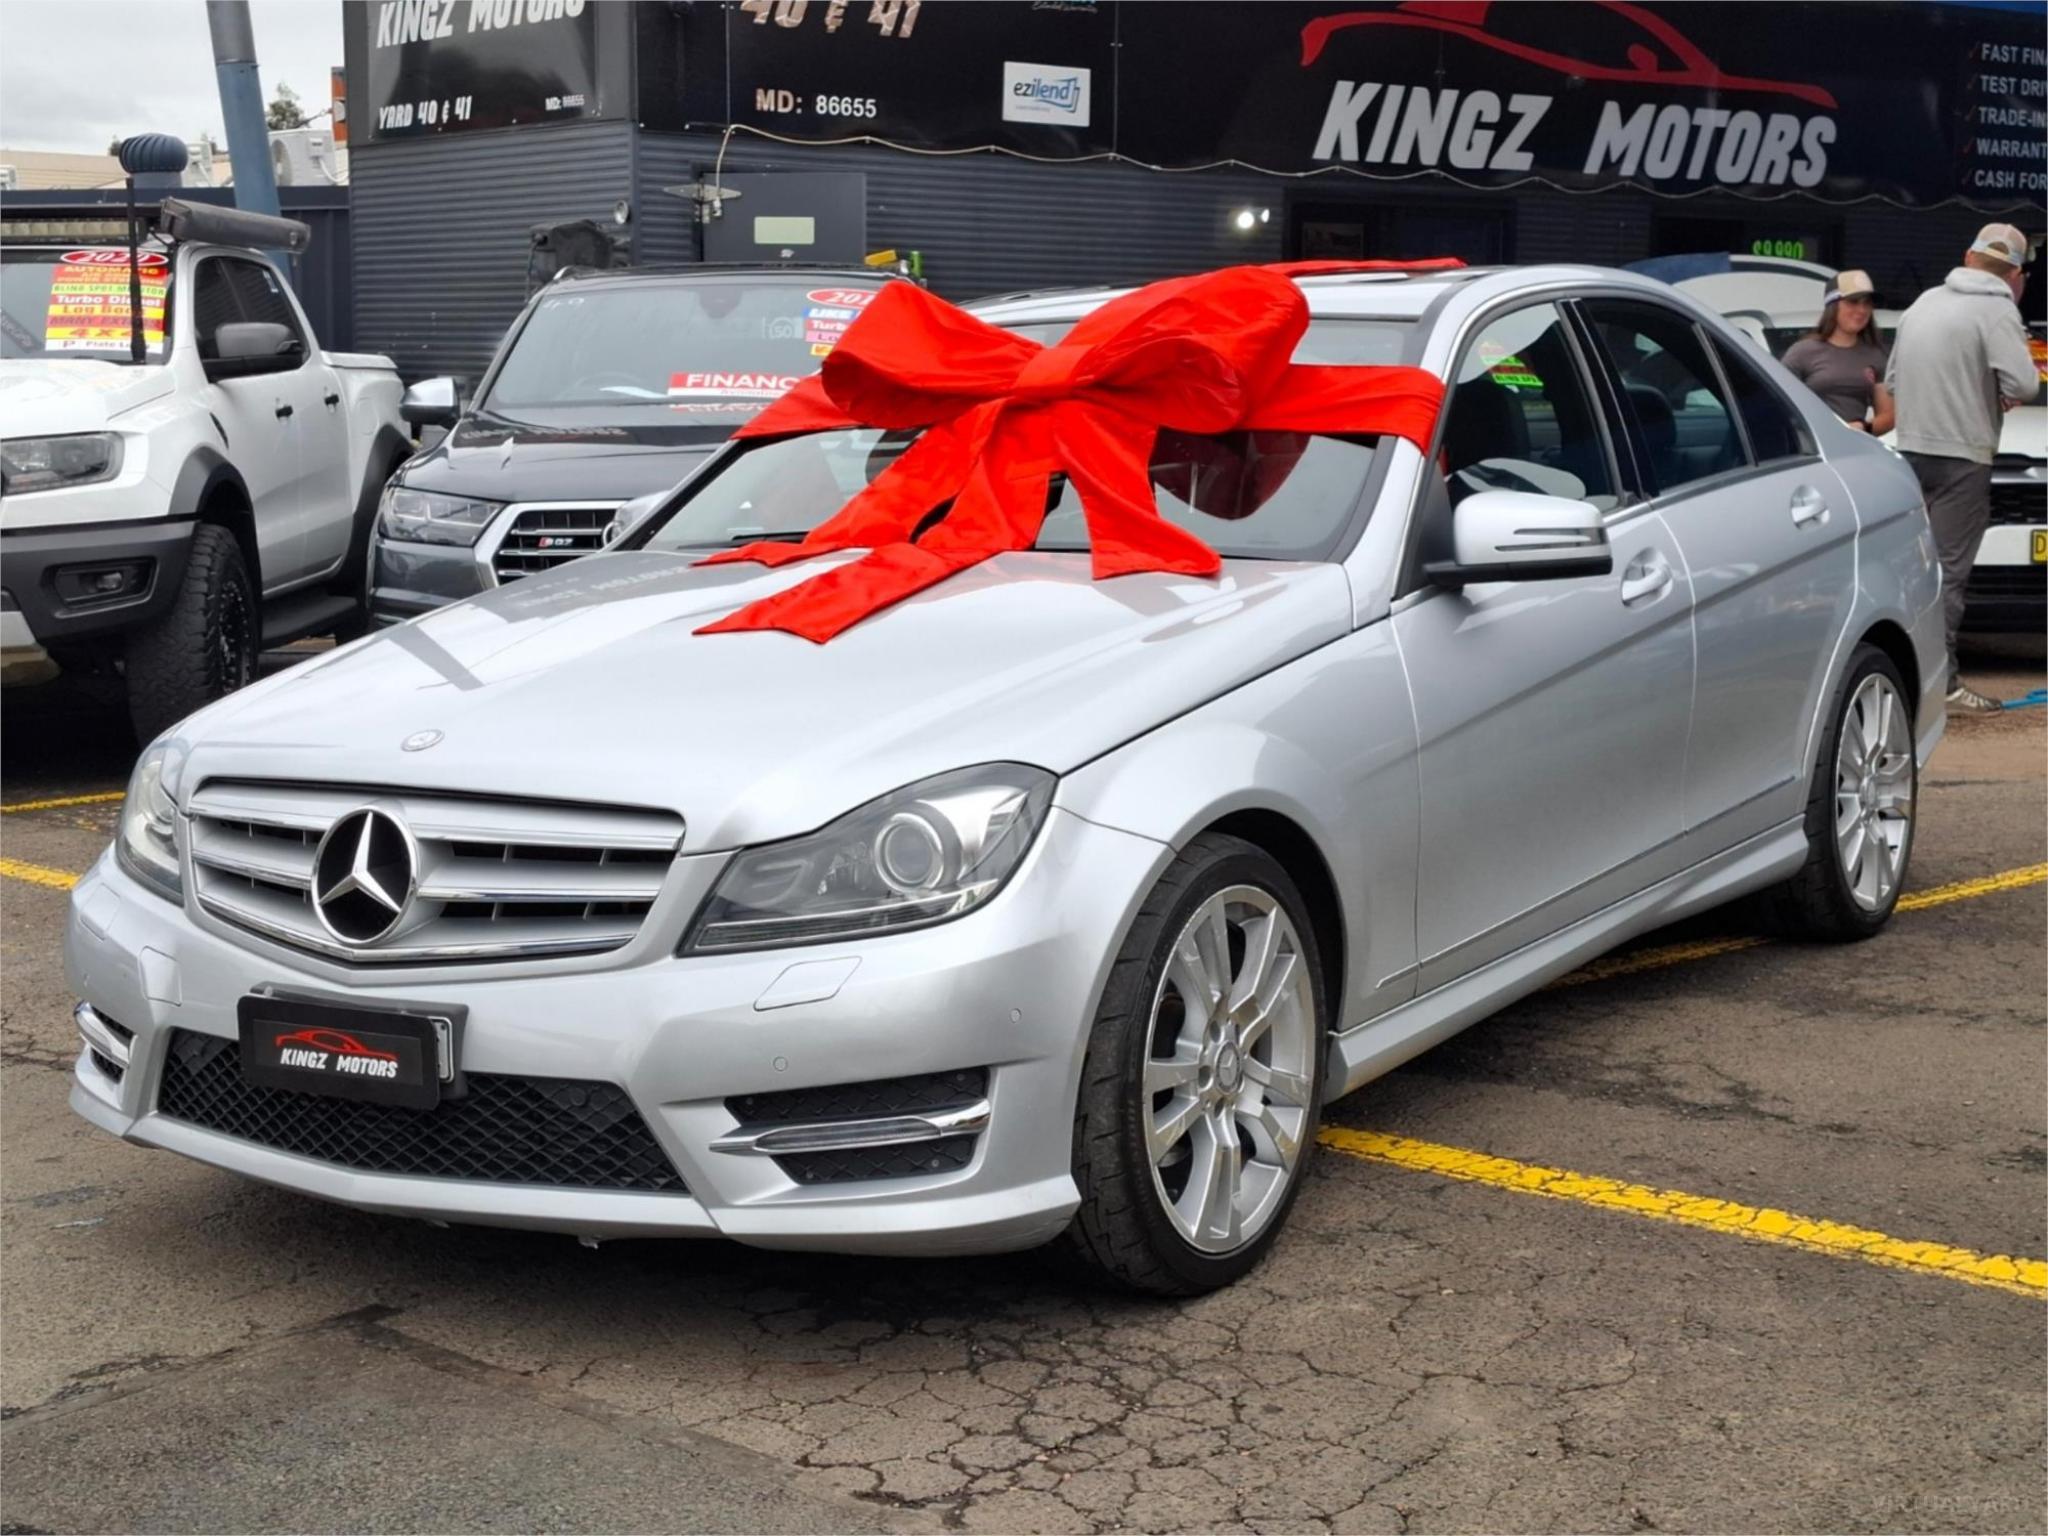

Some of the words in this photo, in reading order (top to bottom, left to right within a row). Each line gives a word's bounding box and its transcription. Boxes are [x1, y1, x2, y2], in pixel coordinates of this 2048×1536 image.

[376, 1, 456, 48] KINGZ
[1980, 42, 2019, 63] FAST
[2021, 47, 2047, 66] FIN
[1979, 74, 2018, 95] TEST
[379, 103, 413, 130] YARD
[418, 99, 438, 125] 40
[455, 96, 472, 121] 41
[755, 88, 802, 114] MD:
[815, 94, 877, 118] 86655
[1312, 79, 1554, 171] KINGZ
[1583, 100, 1837, 187] MOTORS
[1974, 169, 2016, 188] CASH
[2018, 172, 2047, 190] FOR
[80, 251, 150, 263] 2020
[63, 265, 160, 276] AUTOMAIC
[55, 295, 103, 304] Turbo
[826, 291, 875, 305] 201
[685, 373, 801, 389] FINANC
[280, 1048, 328, 1069] KINGZ
[336, 1054, 398, 1078] MOTORS
